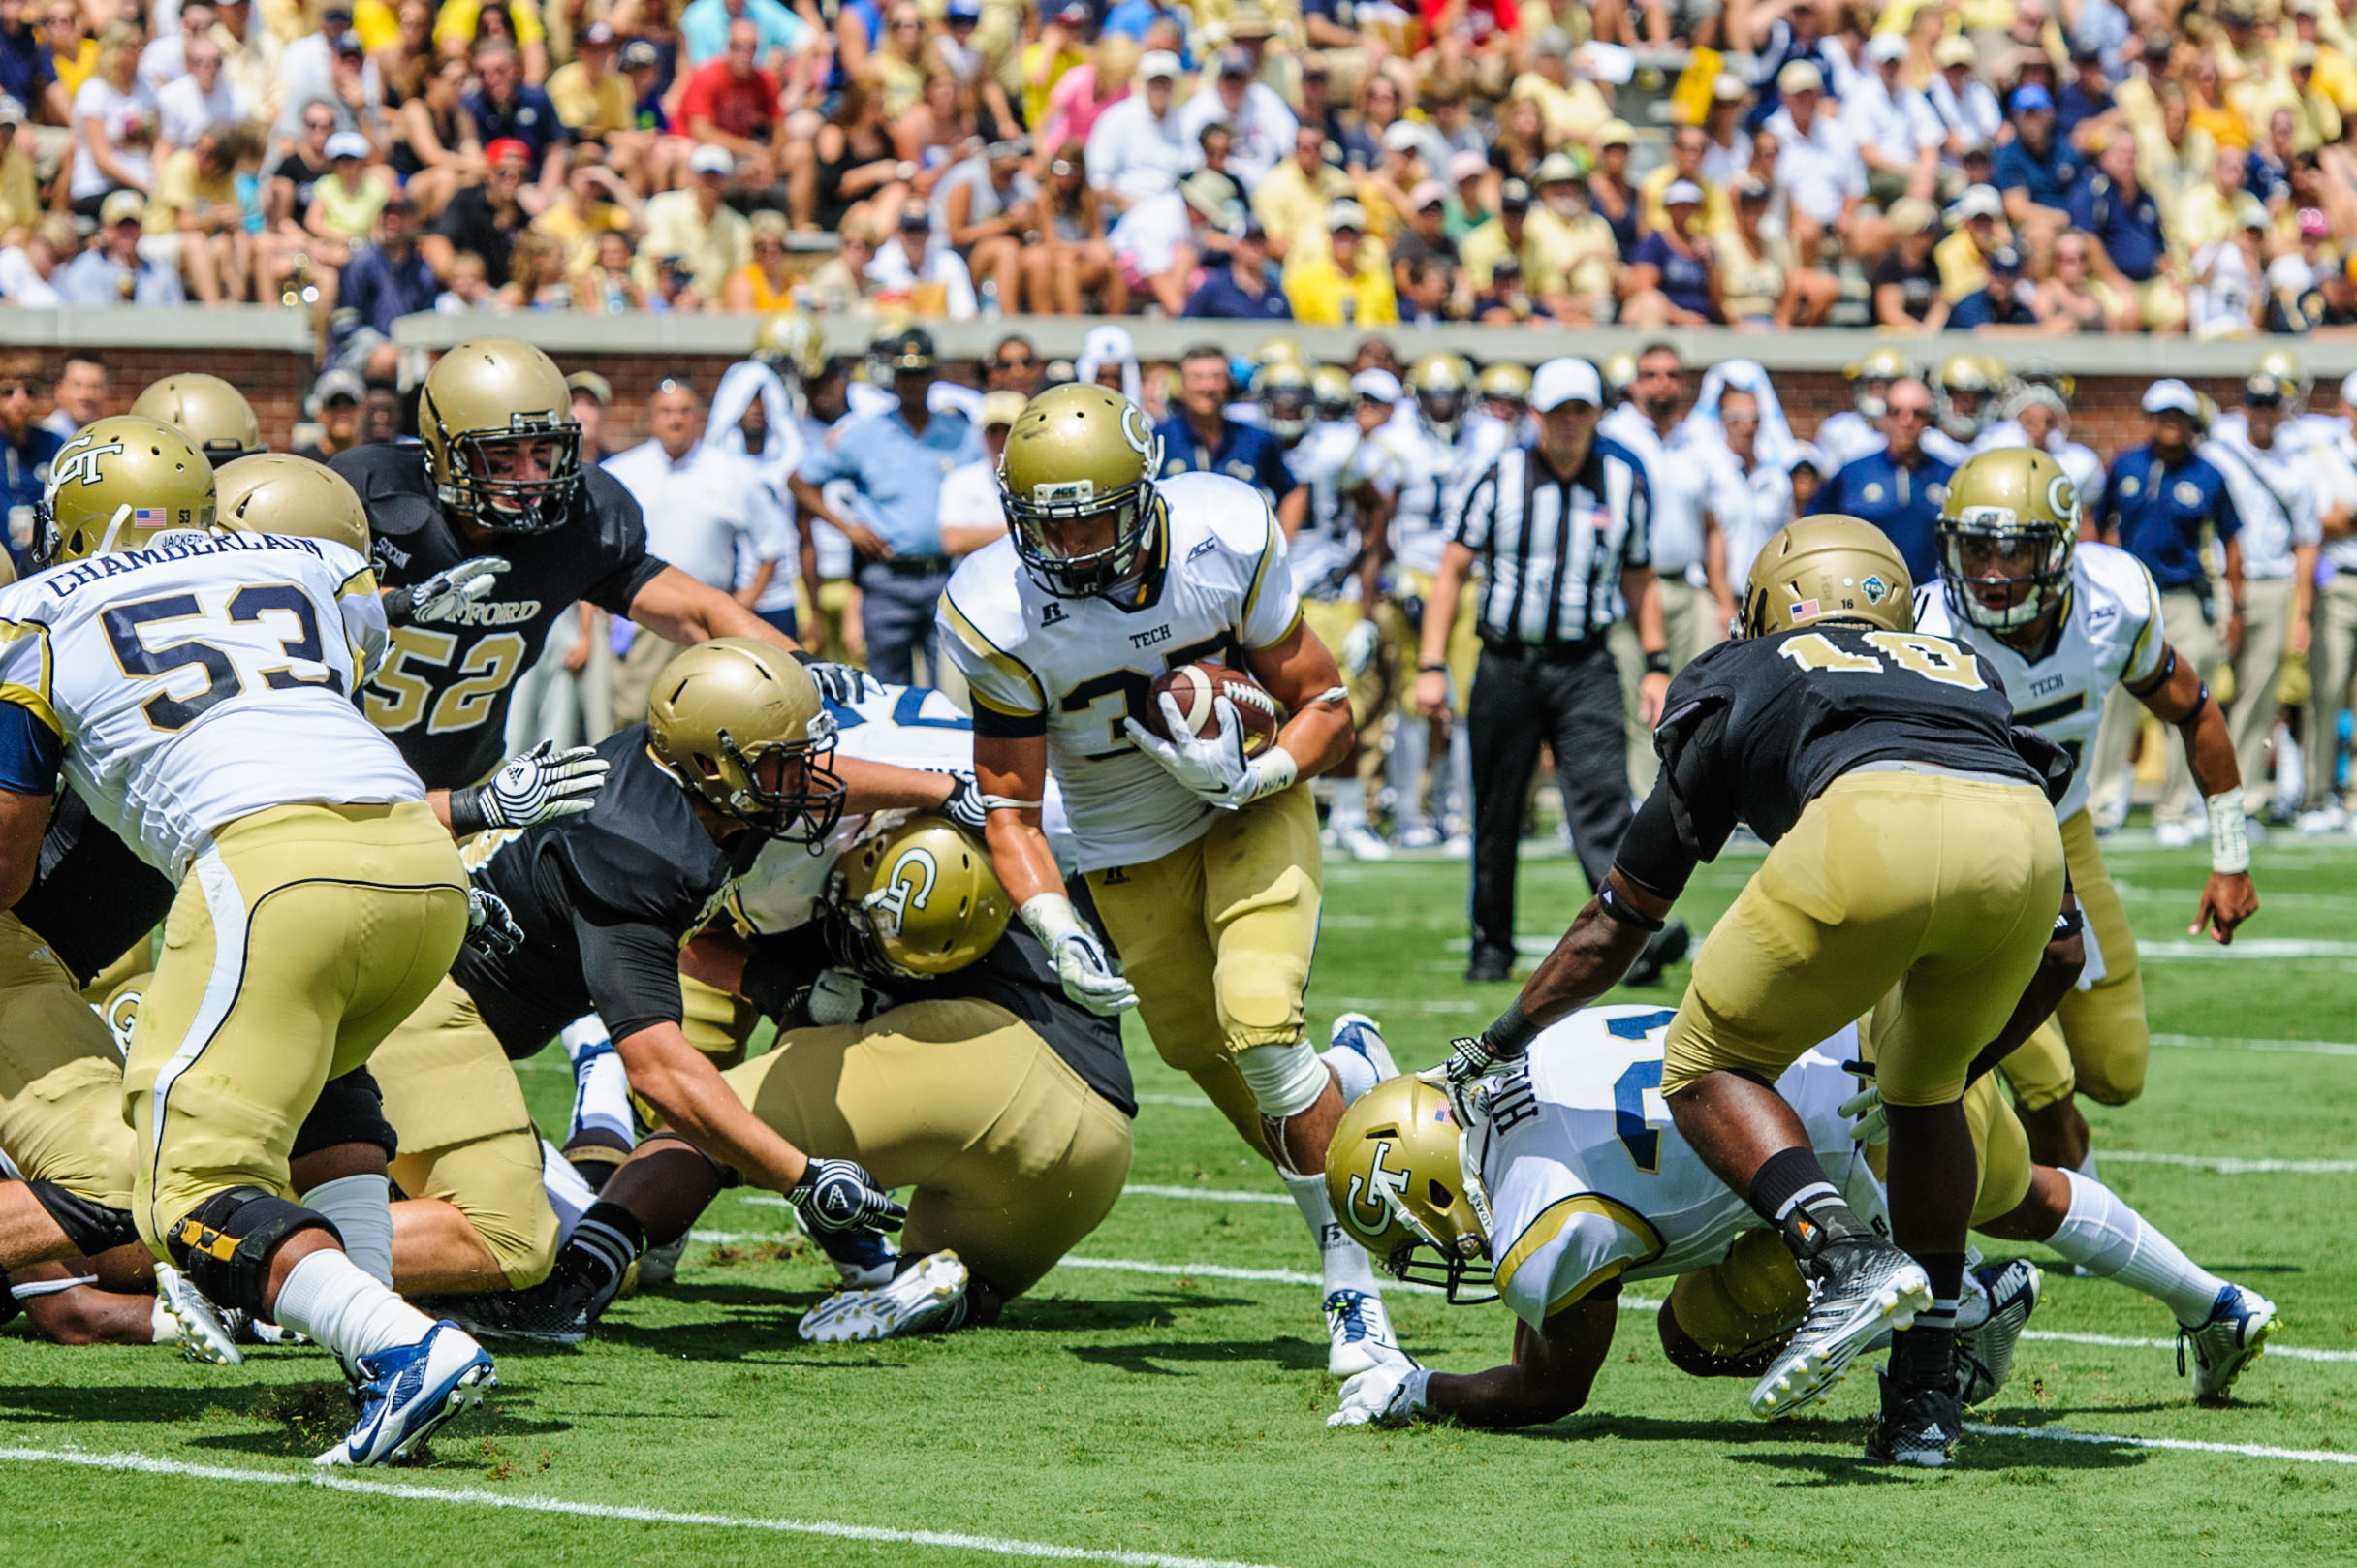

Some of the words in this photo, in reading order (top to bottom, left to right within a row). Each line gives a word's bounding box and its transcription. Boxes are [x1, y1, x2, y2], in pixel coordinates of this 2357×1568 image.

[178, 509, 191, 524] 53
[376, 536, 412, 569] SOCON
[1186, 537, 1215, 564] ACC
[1841, 598, 1854, 610] 16
[1129, 624, 1172, 649] TECH
[97, 581, 345, 734] 53
[363, 625, 527, 736] 52
[2029, 674, 2064, 698] TECH
[1490, 1051, 1539, 1137] HIL
[1992, 1262, 2028, 1308] NIKE
